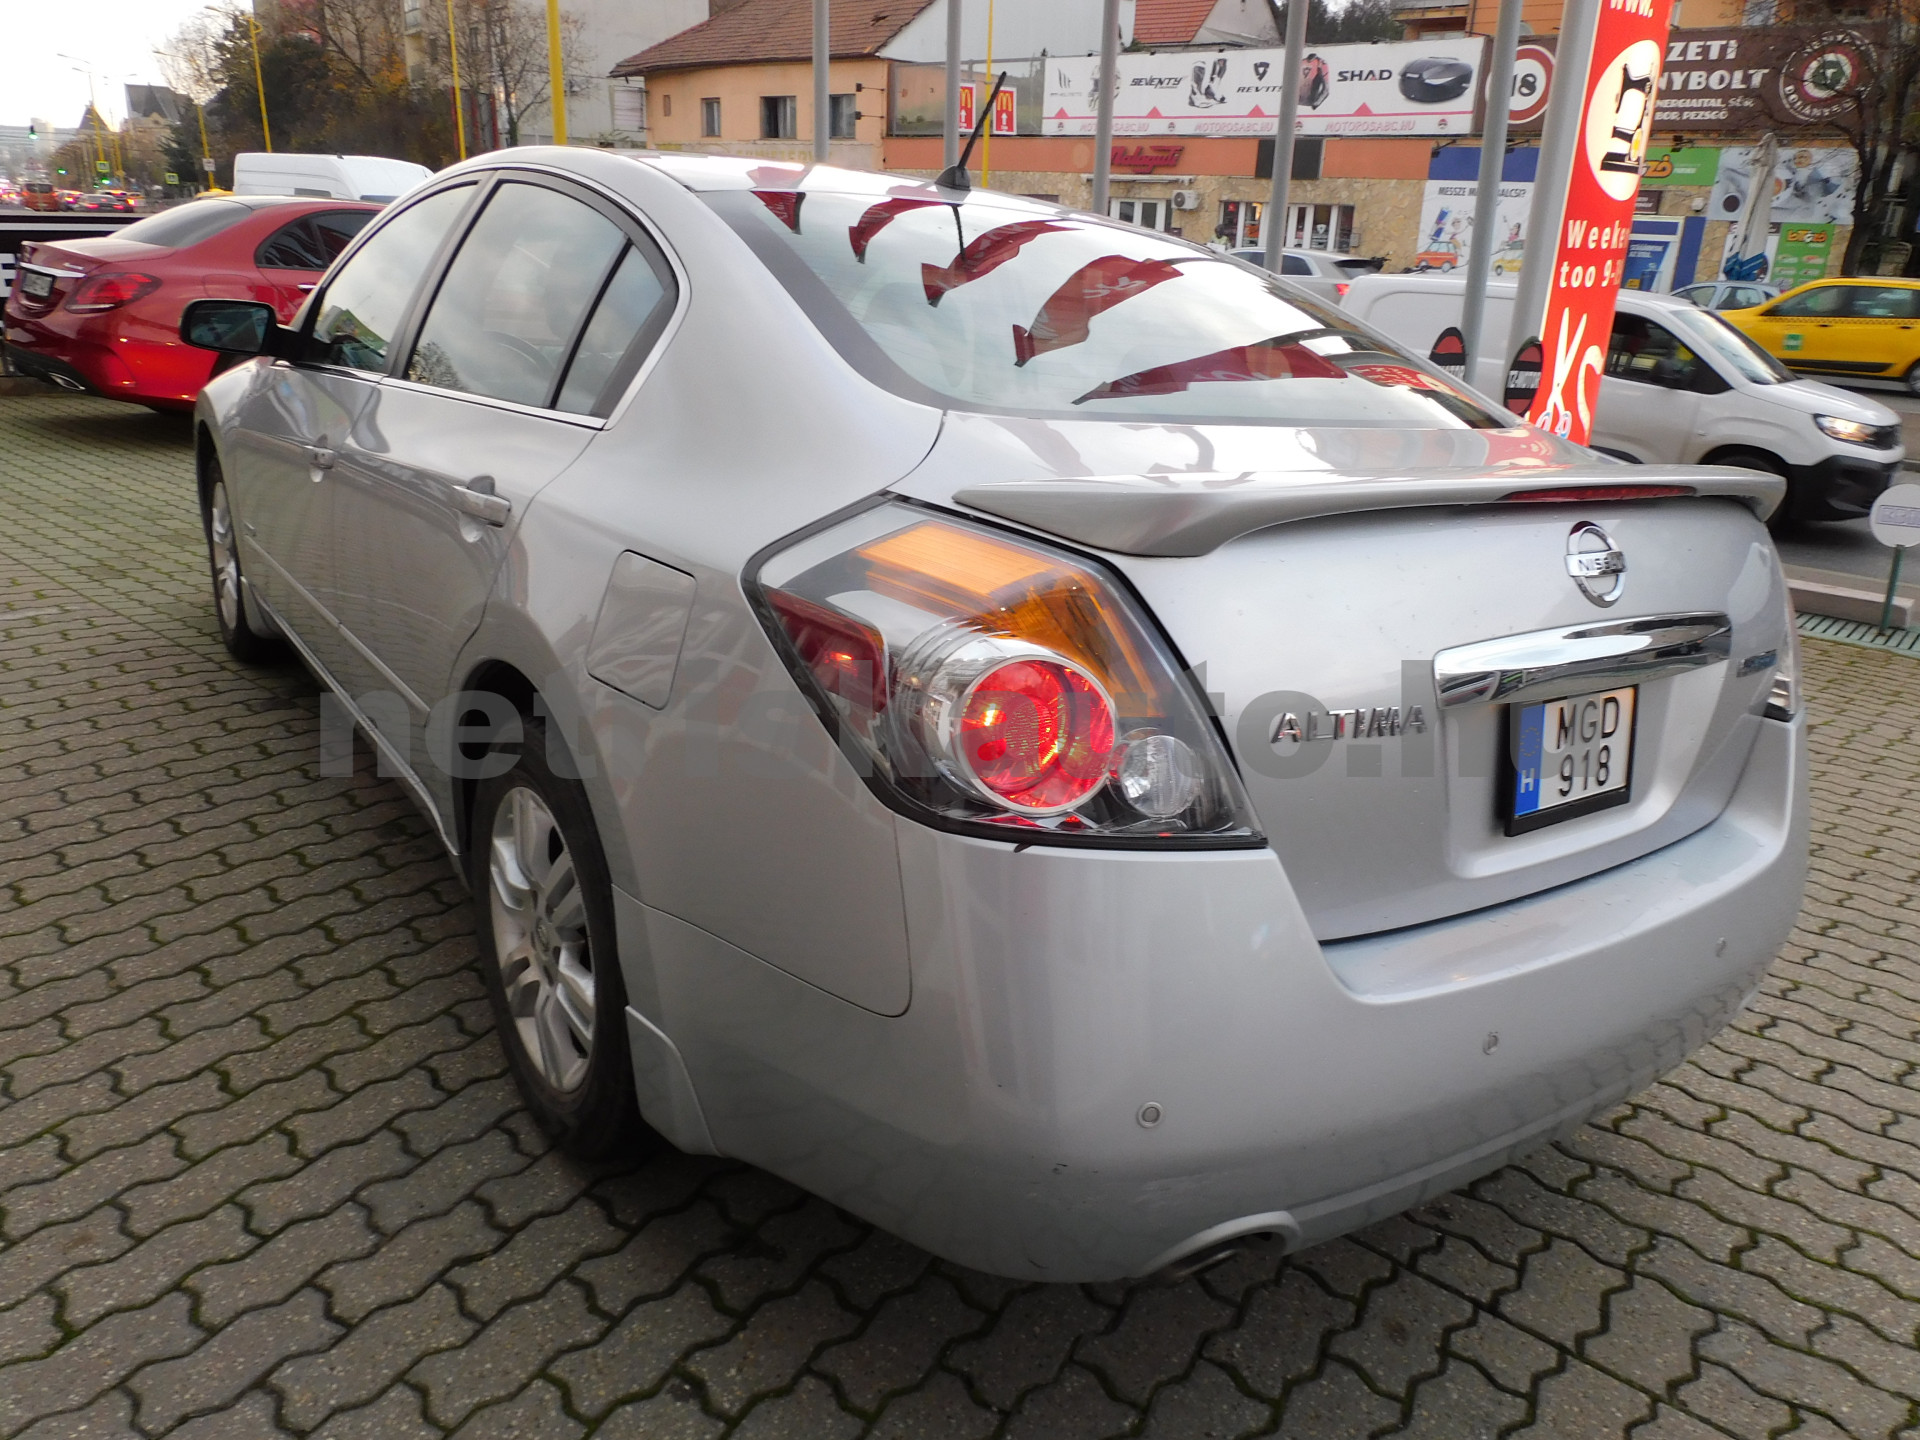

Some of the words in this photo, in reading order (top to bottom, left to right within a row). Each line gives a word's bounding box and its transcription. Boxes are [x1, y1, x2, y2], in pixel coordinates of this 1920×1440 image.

[1665, 40, 1738, 61] ZETI
[1130, 75, 1183, 89] SEVENTY
[1337, 69, 1393, 82] SHAD
[1511, 73, 1537, 97] 18
[1658, 69, 1770, 91] NYBOLT
[1559, 261, 1596, 289] too
[1578, 555, 1625, 572] NISSAN
[1271, 704, 1428, 744] ALTIMA
[1556, 696, 1620, 750] MGD
[1519, 766, 1535, 794] H
[1558, 744, 1611, 797] 918
